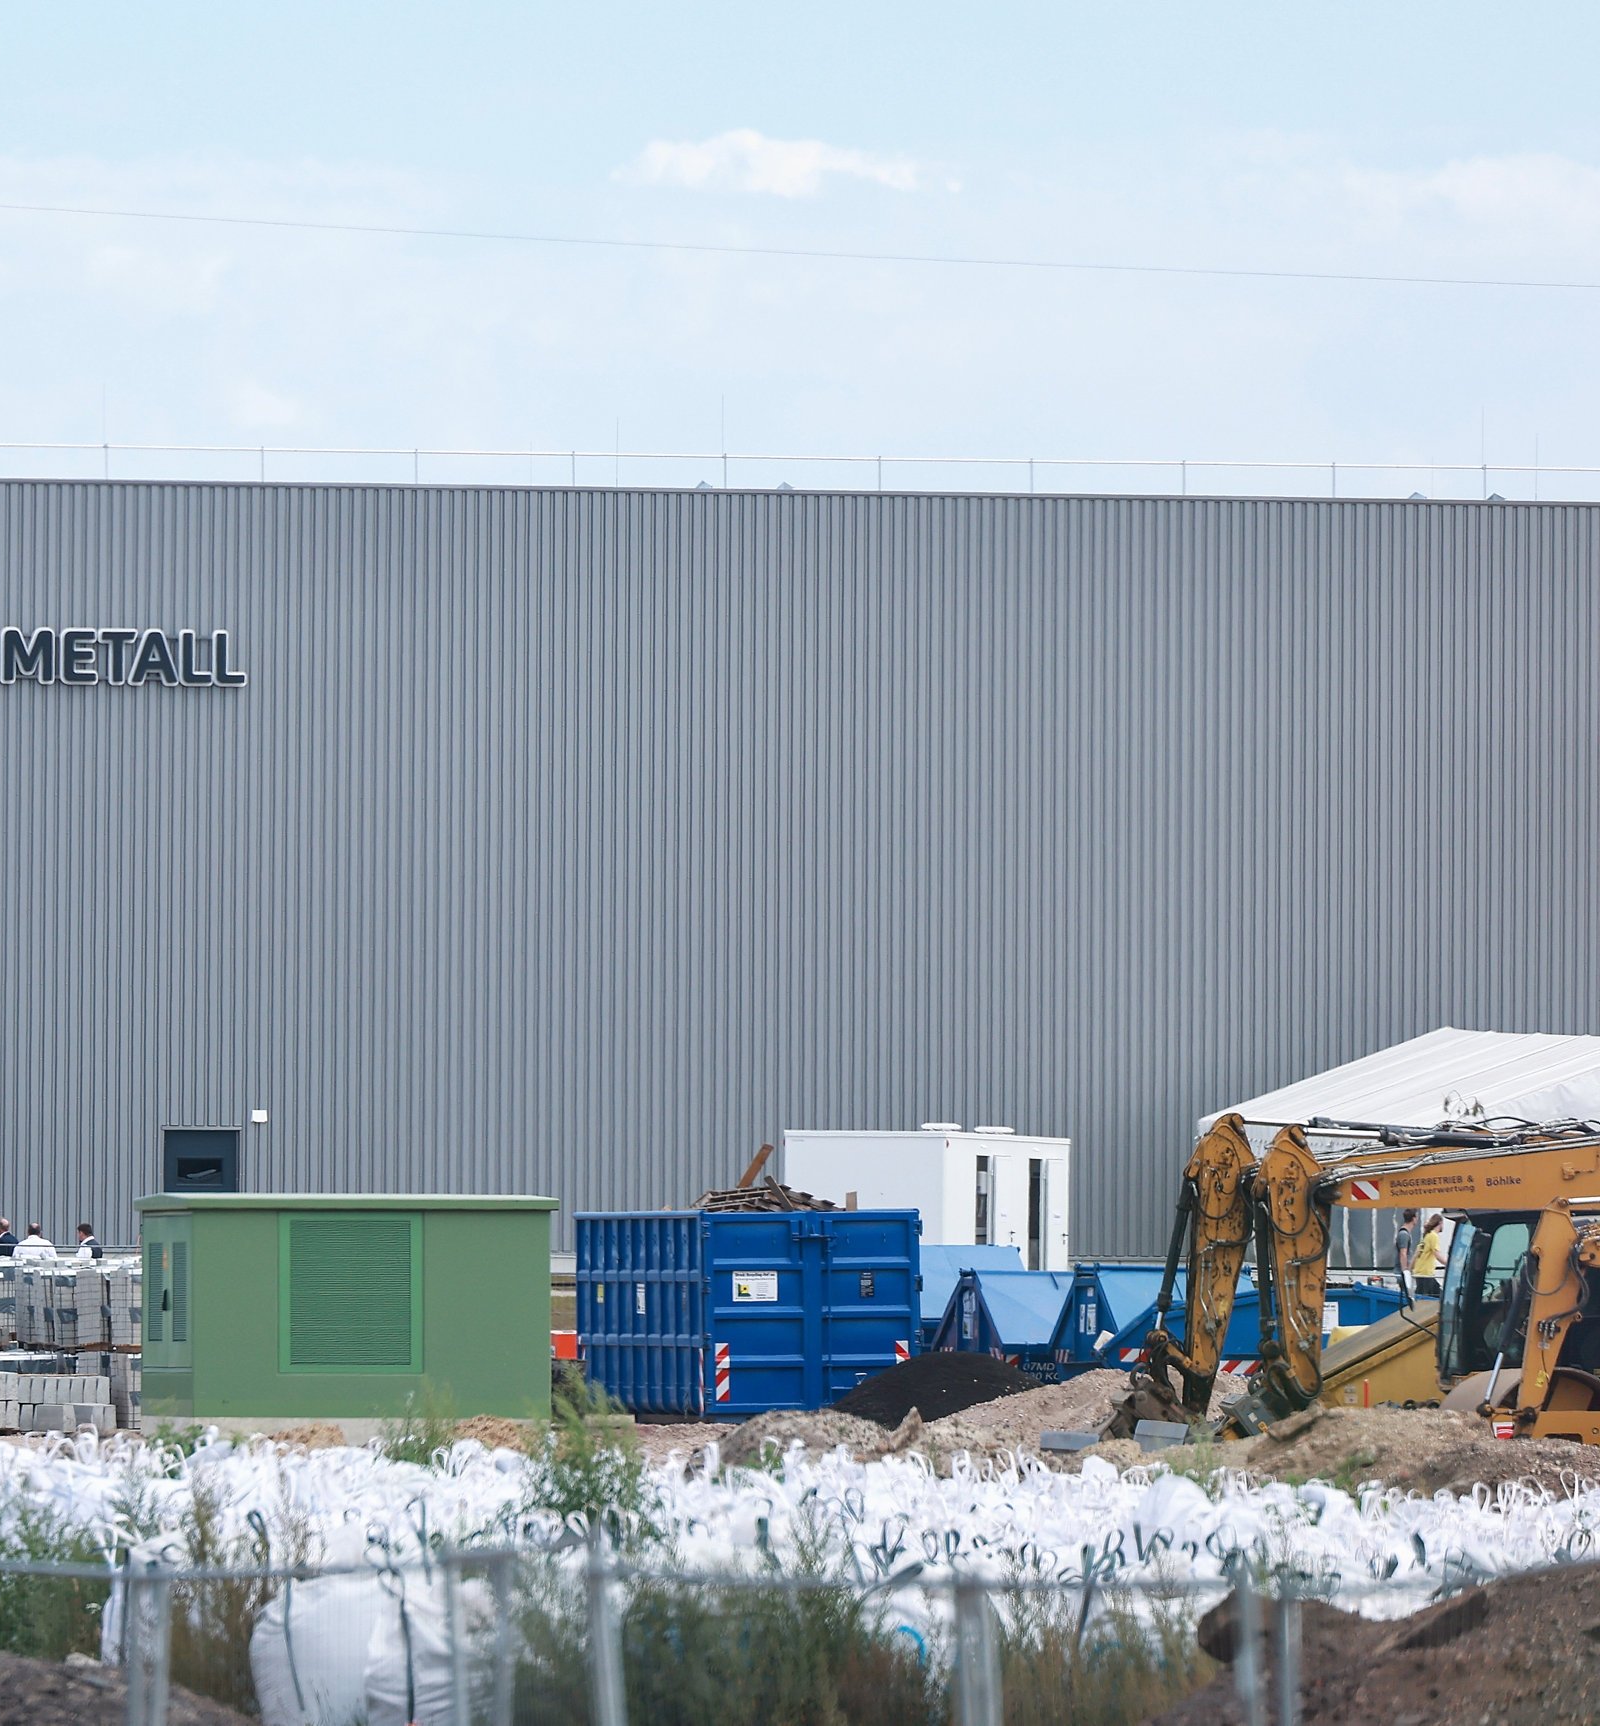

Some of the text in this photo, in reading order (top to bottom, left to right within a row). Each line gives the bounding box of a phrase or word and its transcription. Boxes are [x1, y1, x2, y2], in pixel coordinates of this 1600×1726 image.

[1390, 1174, 1474, 1188] BAGGERBETRIEB &
[1485, 1175, 1521, 1187] Böhlke
[1390, 1185, 1475, 1196] Schrottverwertung
